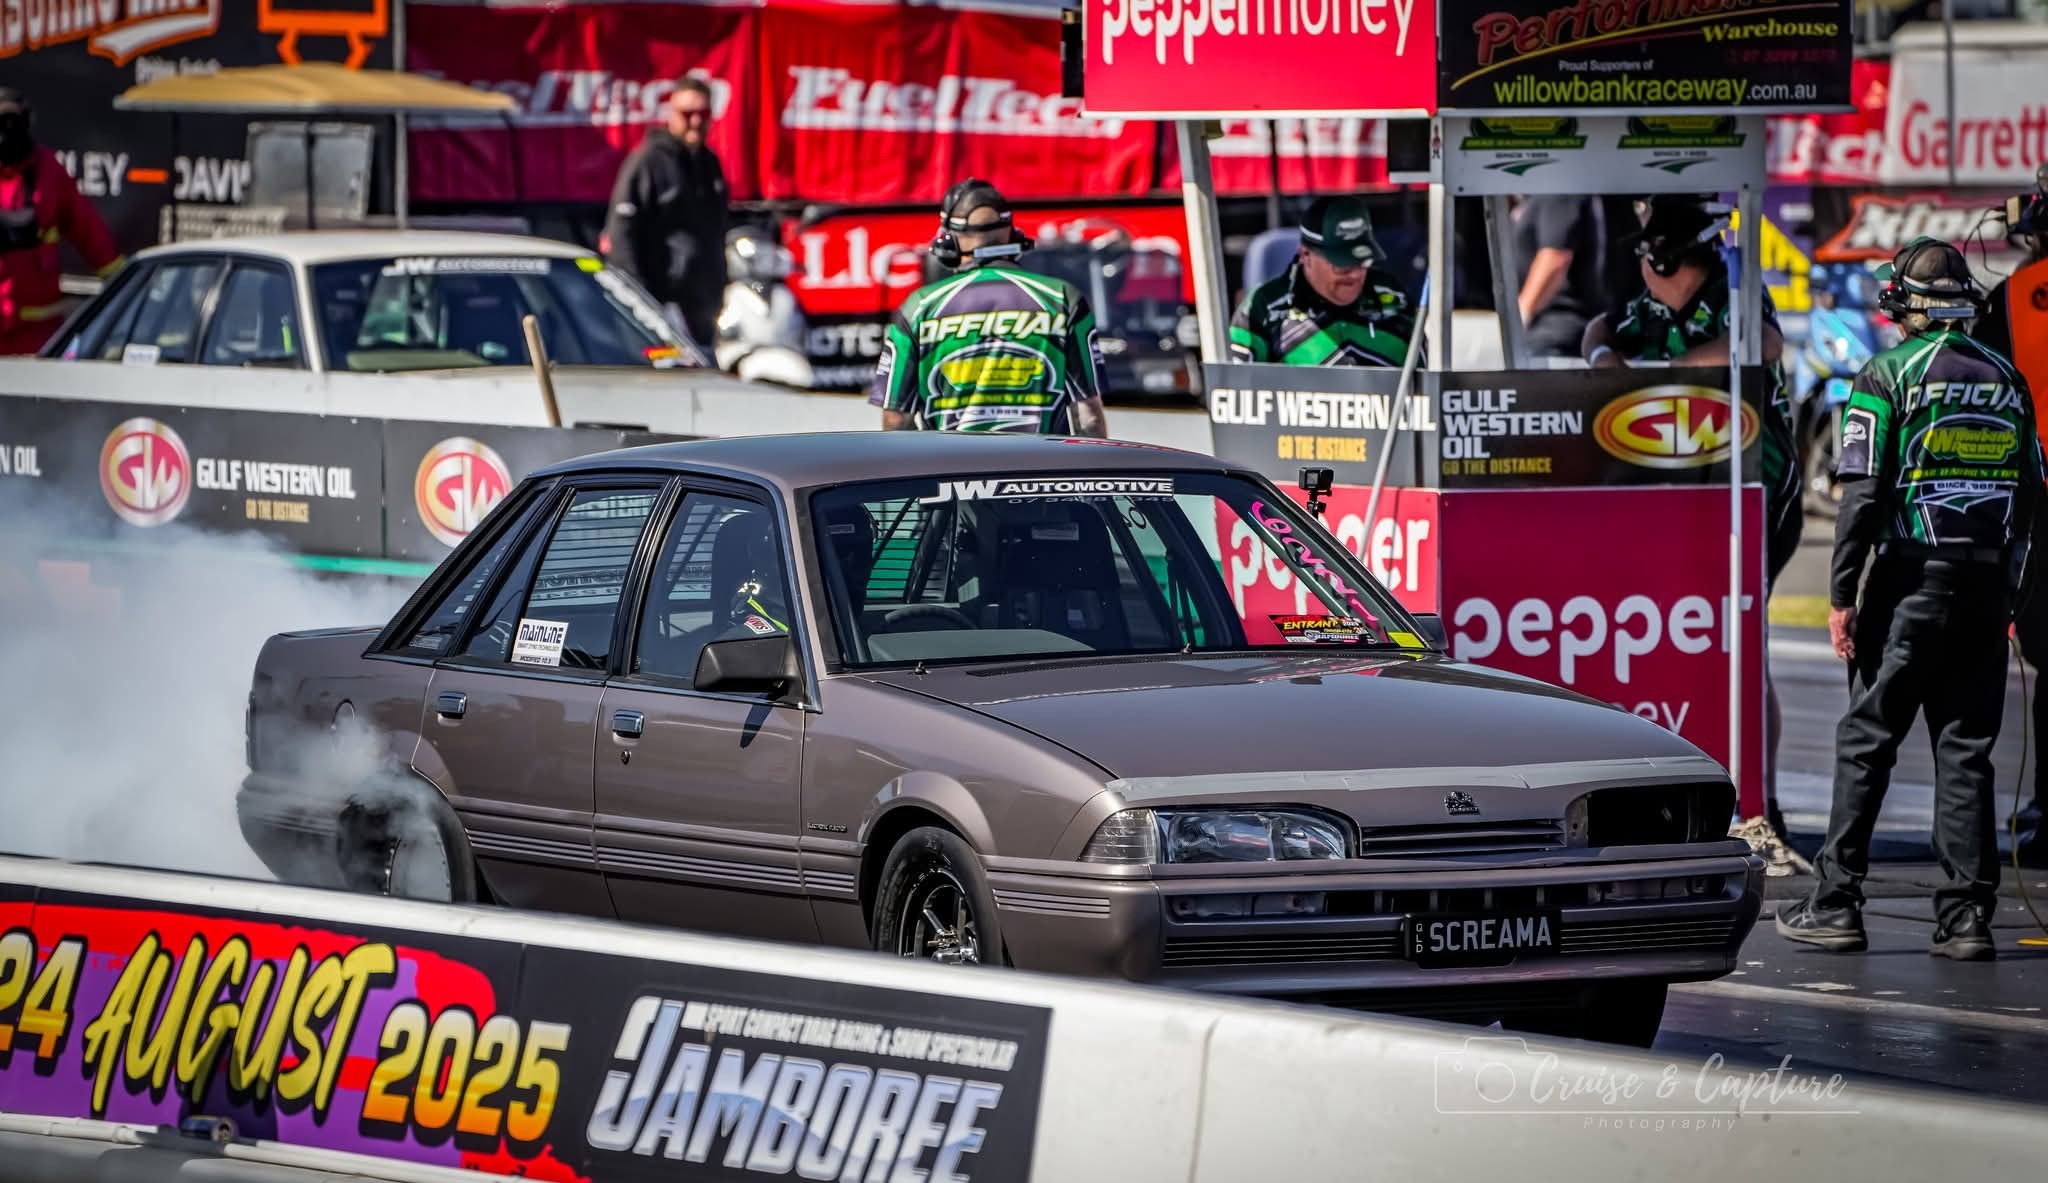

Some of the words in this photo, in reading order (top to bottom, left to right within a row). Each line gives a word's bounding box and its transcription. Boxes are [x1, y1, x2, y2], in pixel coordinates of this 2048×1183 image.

[1703, 18, 1838, 42] Warehouse
[1559, 60, 1587, 71] Proud
[1590, 59, 1641, 72] Supporters
[1643, 58, 1655, 70] of
[1494, 75, 1818, 105] willowbankraceway.com.au
[920, 310, 1066, 345] OFFICIAL
[1210, 388, 1273, 426] GULF
[1276, 391, 1390, 430] WESTERN
[1442, 390, 1517, 413] GULF
[1905, 382, 2025, 414] OFFICIA
[1443, 411, 1582, 437] WESTERN
[14, 445, 42, 477] OIL
[1442, 436, 1490, 459] OIL
[197, 457, 241, 491] GULF
[244, 460, 325, 497] WESTERN
[327, 466, 356, 499] OIL
[1443, 459, 1459, 475] GO
[1464, 459, 1486, 475] THE
[1490, 457, 1553, 474] DISTANCE
[919, 481, 1000, 504] JW
[1002, 482, 1173, 494] AUTOMOTIVE
[1283, 619, 1338, 630] ENTRANT
[1453, 594, 1754, 684] pepper
[1430, 916, 1552, 951] SCREAMA
[84, 934, 395, 1112] AUGUST
[362, 1003, 572, 1142] 2025
[586, 996, 1003, 1183] JAMBOREE
